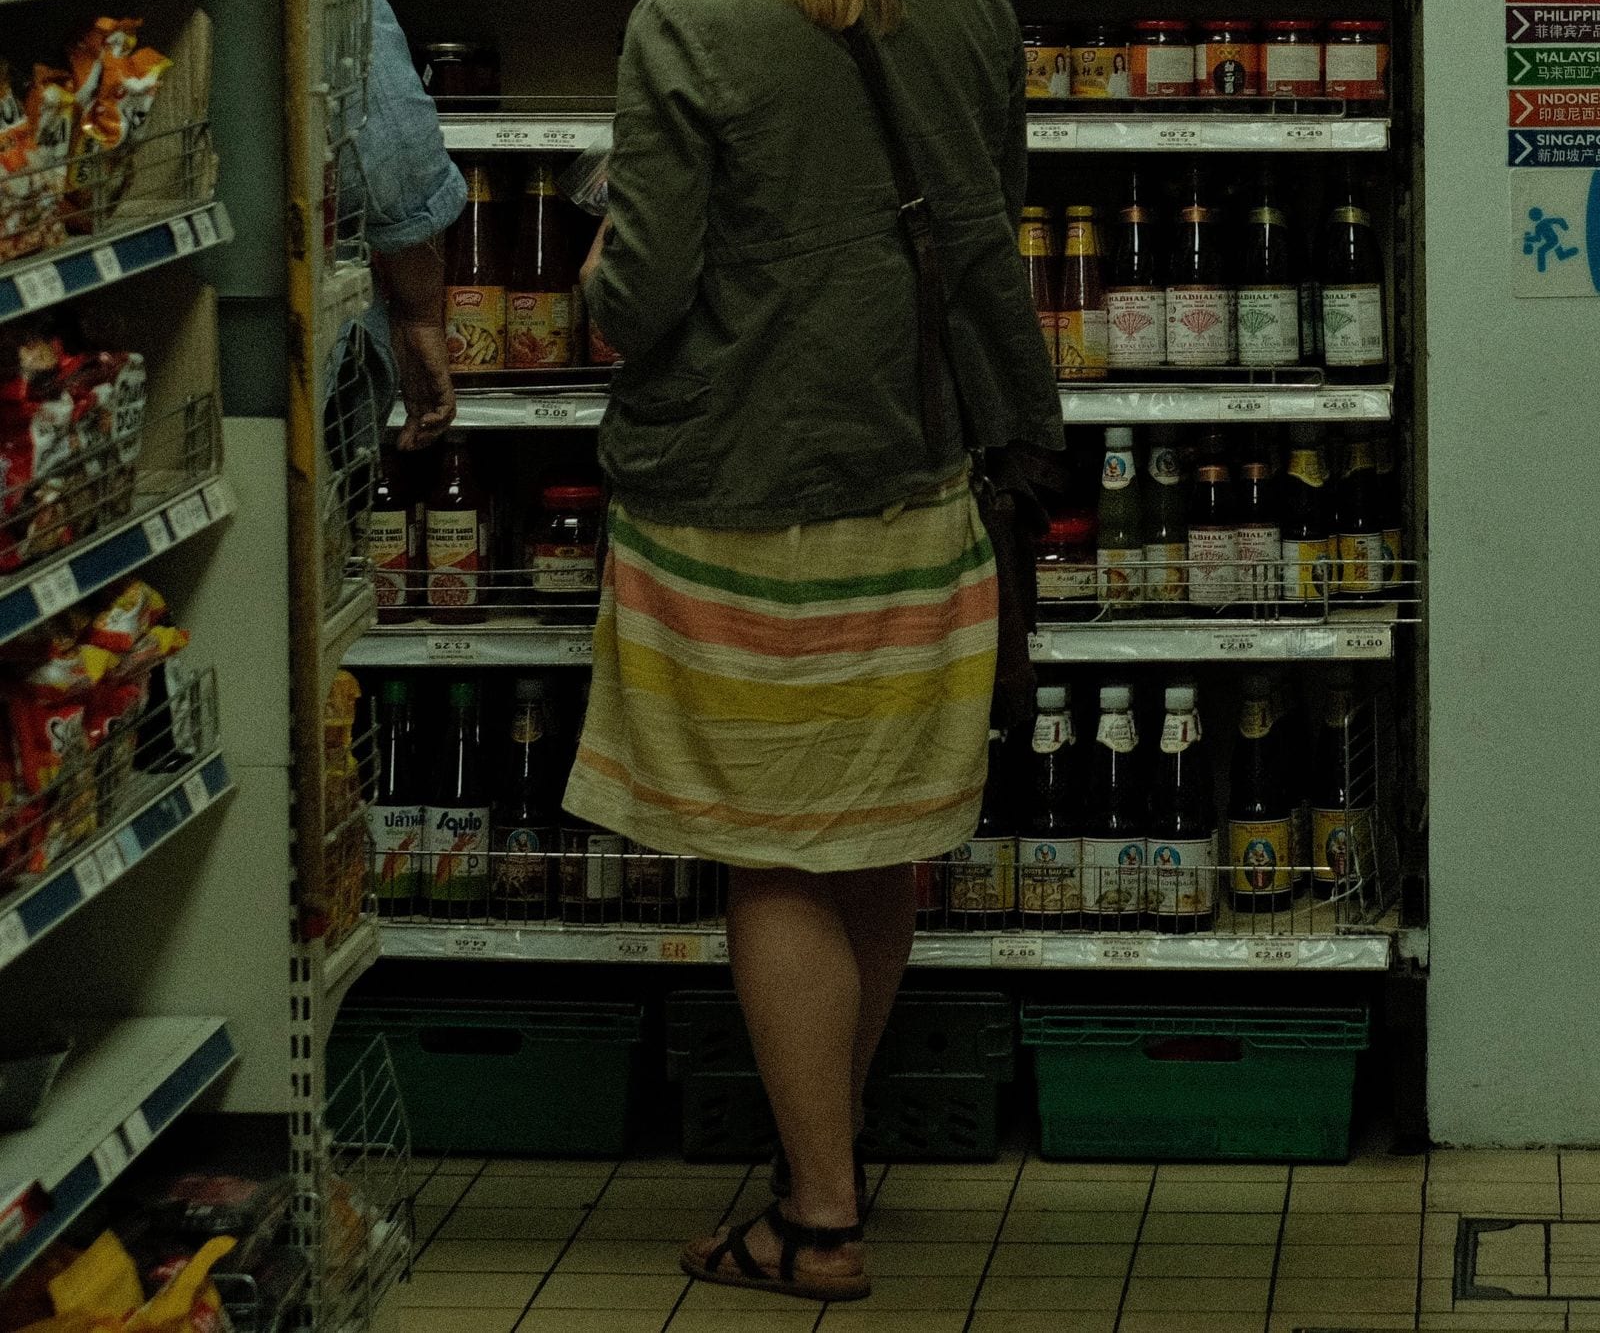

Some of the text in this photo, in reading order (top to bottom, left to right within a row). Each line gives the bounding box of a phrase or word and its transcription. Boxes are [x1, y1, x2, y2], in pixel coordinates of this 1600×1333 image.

[1537, 92, 1600, 105] INDONE
[1287, 129, 1323, 138] £1.49
[1346, 638, 1383, 647] £1.60
[568, 645, 592, 653] £3.4
[1103, 950, 1140, 959] £2.95
